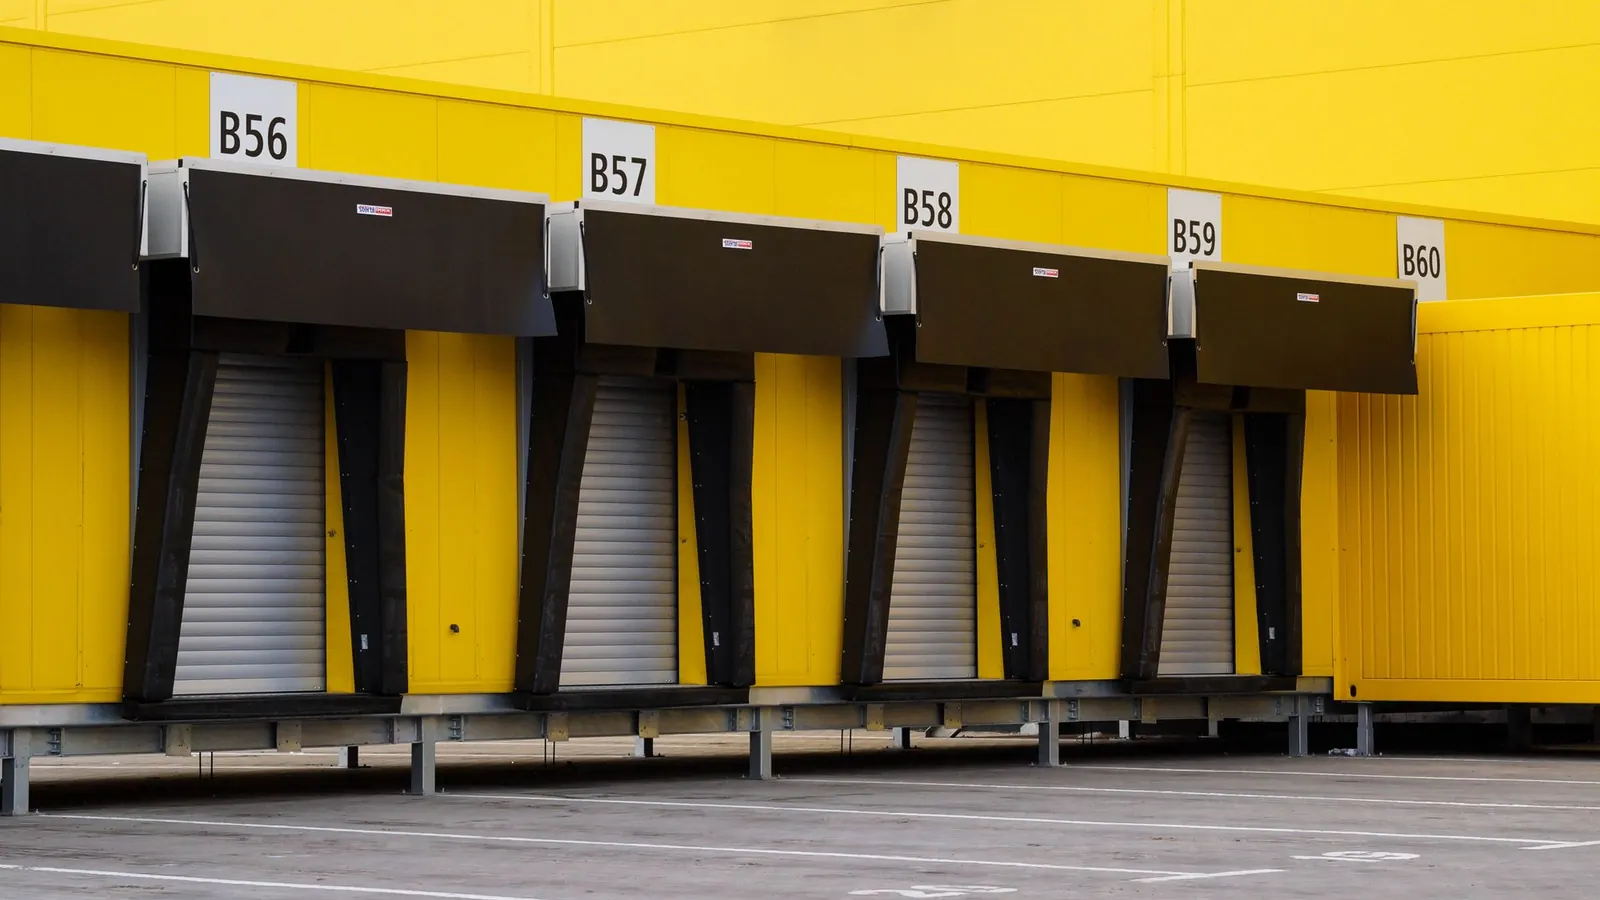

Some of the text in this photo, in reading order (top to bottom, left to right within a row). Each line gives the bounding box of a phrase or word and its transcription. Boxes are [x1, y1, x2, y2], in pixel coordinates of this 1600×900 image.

[220, 110, 288, 161] B56
[591, 152, 647, 197] B57
[903, 187, 952, 229] B58
[1173, 218, 1216, 257] B59
[1403, 243, 1441, 279] B60
